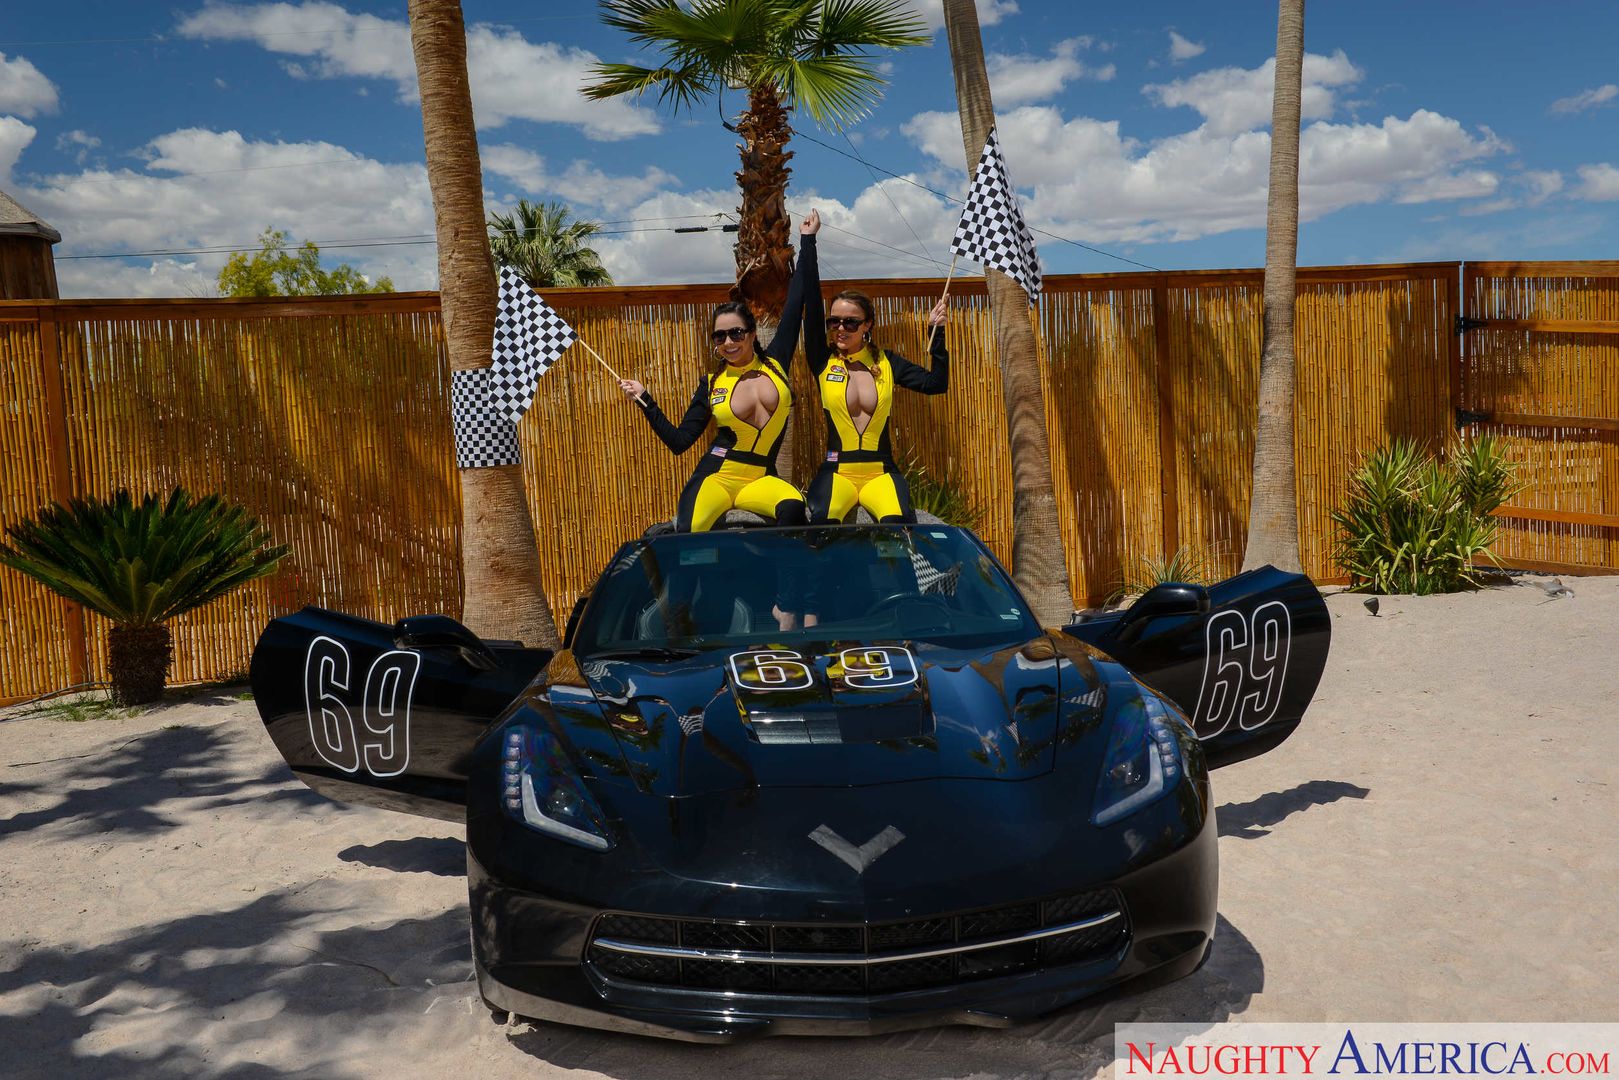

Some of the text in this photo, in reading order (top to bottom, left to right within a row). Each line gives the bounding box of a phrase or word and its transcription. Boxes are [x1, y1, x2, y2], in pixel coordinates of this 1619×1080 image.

[305, 636, 420, 777] 69
[729, 646, 919, 691] 69
[1192, 601, 1291, 741] 69
